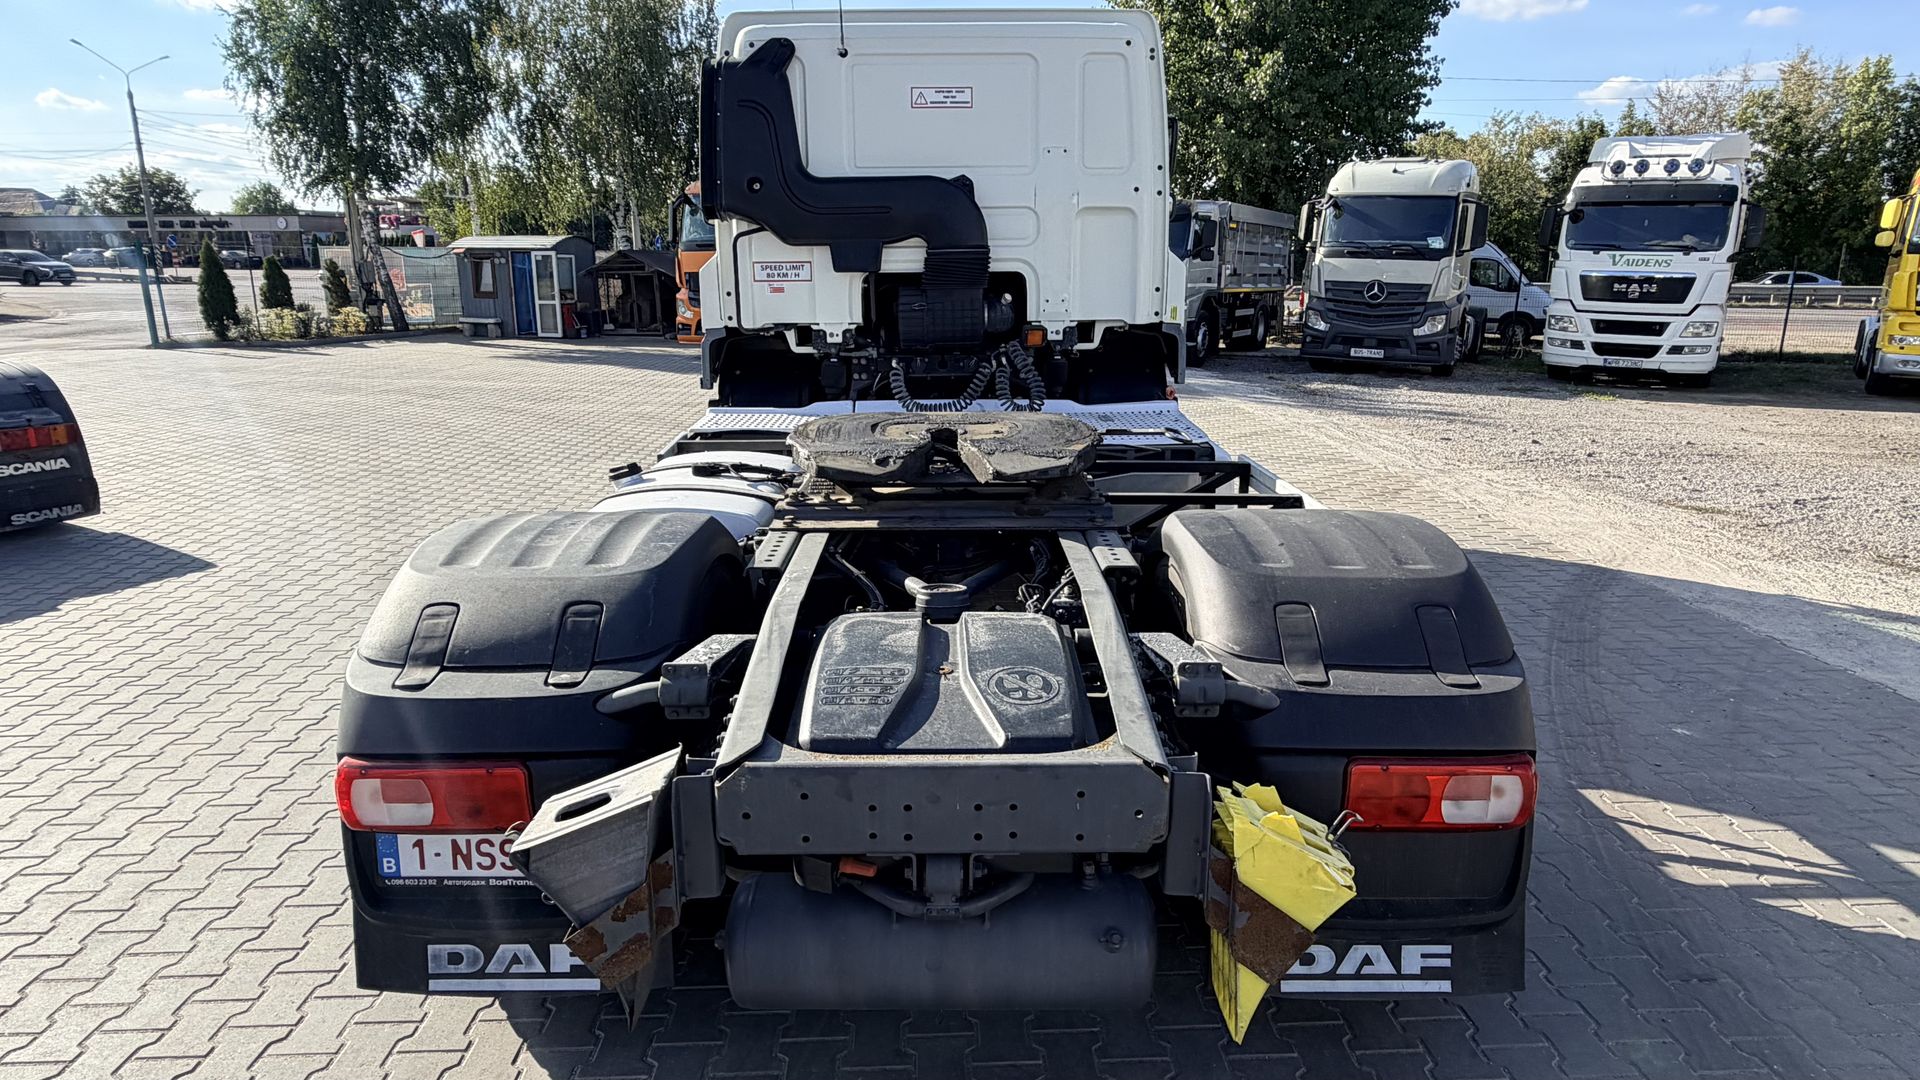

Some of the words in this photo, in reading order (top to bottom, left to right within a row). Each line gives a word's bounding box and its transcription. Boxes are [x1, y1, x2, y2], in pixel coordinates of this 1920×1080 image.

[760, 264, 784, 272] SPEED
[785, 264, 805, 272] LIMIT
[1607, 253, 1674, 268] VAIDENS
[1612, 283, 1657, 292] MAN
[0, 457, 71, 477] SCANIA
[10, 503, 85, 526] SCANIA
[382, 857, 397, 873] B
[443, 878, 486, 887] Автопродаж
[427, 944, 587, 974] DAF
[1285, 944, 1452, 975] DAF
